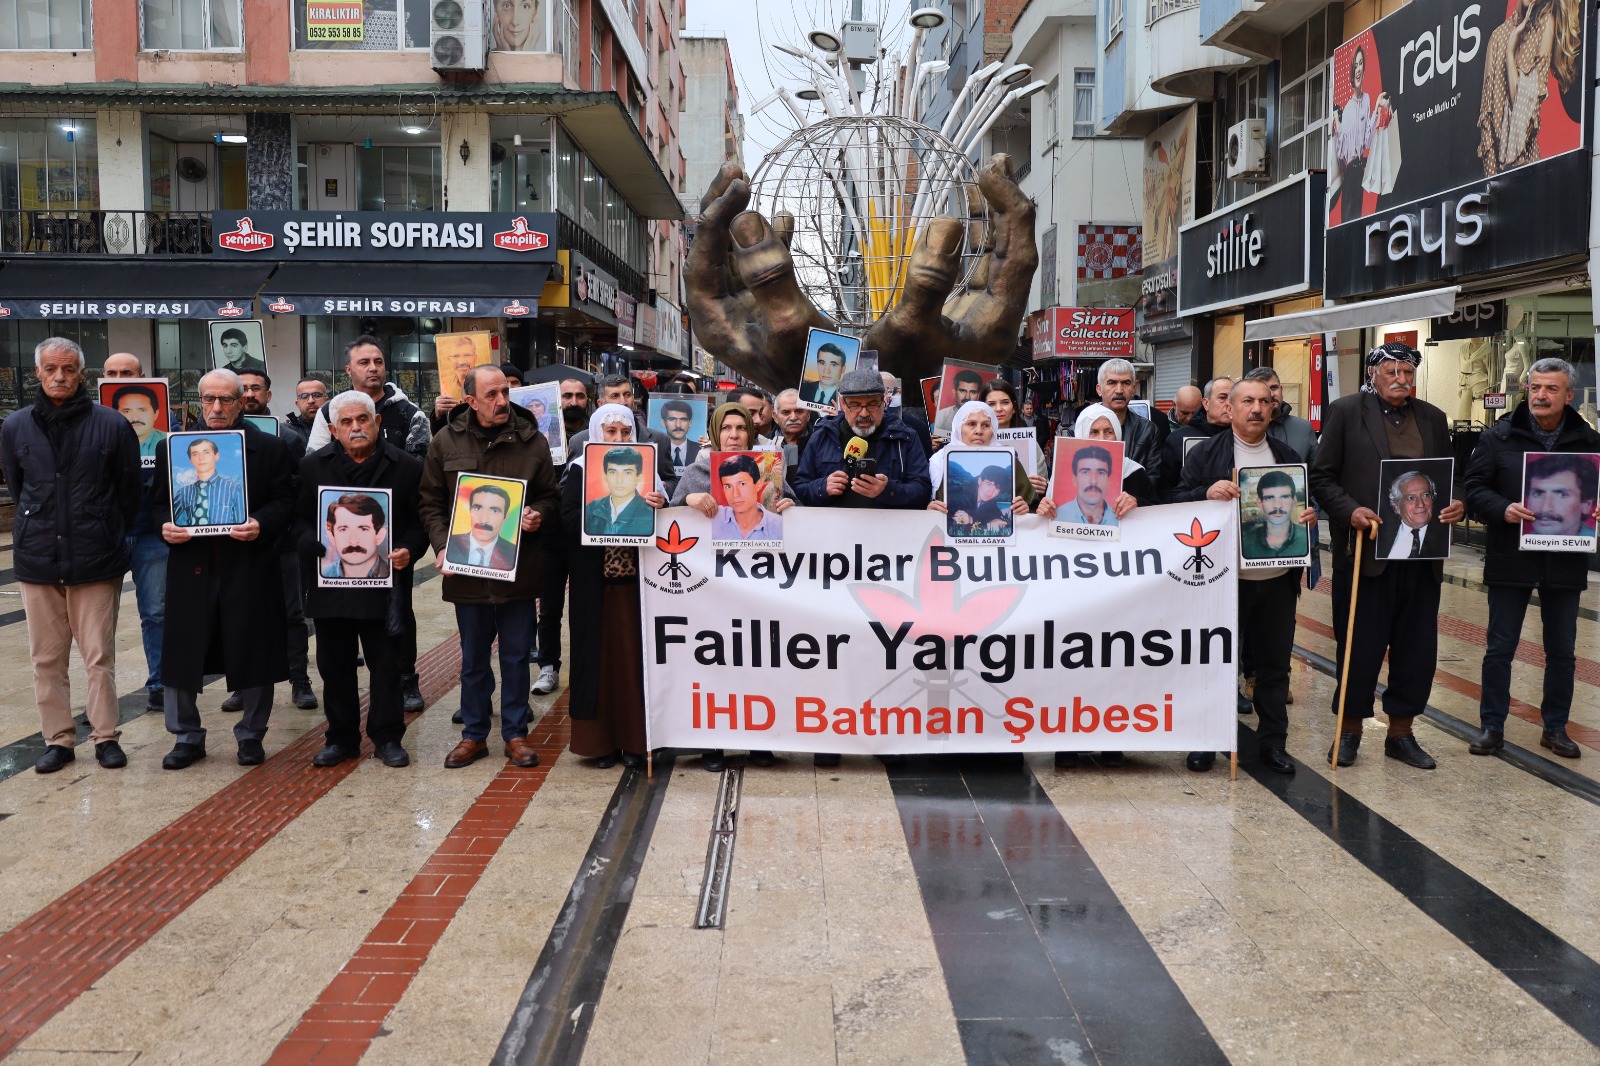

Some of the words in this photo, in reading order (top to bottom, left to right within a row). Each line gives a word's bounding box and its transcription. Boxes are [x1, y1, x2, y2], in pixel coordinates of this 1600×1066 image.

[309, 27, 326, 38] 0532
[328, 27, 340, 38] 553
[342, 27, 350, 38] 58
[353, 27, 361, 38] 85
[1400, 4, 1481, 94] rays
[1426, 107, 1434, 118] de
[283, 215, 361, 253] ŞEHİR
[370, 222, 483, 248] SOFRASI
[1365, 192, 1487, 269] rays
[225, 234, 267, 247] şenpiliç
[500, 233, 541, 246] şenpiliç
[1206, 212, 1264, 278] stilife
[40, 301, 99, 317] ŞEHİR
[105, 303, 189, 315] SOFRASI
[324, 298, 383, 313] ŞEHİR
[390, 300, 475, 313] SOFRASI
[1070, 311, 1119, 329] Şirin
[1060, 327, 1128, 338] Collection
[1013, 431, 1034, 439] ÇELİK
[1056, 525, 1074, 535] Eset
[1076, 526, 1113, 537] GÖKTAYI
[740, 540, 754, 548] ZEKİ
[1525, 538, 1560, 547] Hüseyin
[1562, 538, 1591, 547] SEVİM
[715, 543, 913, 590] Kayıplar
[930, 546, 1163, 583] Bulunsun
[1277, 558, 1307, 566] DEMİREL
[471, 568, 510, 579] DEĞİRMENCİ
[654, 615, 850, 669] Failler
[868, 619, 1232, 683] Yargılansın
[691, 682, 776, 731] İHD
[795, 696, 984, 736] Batman
[1003, 693, 1173, 744] Şubesi
